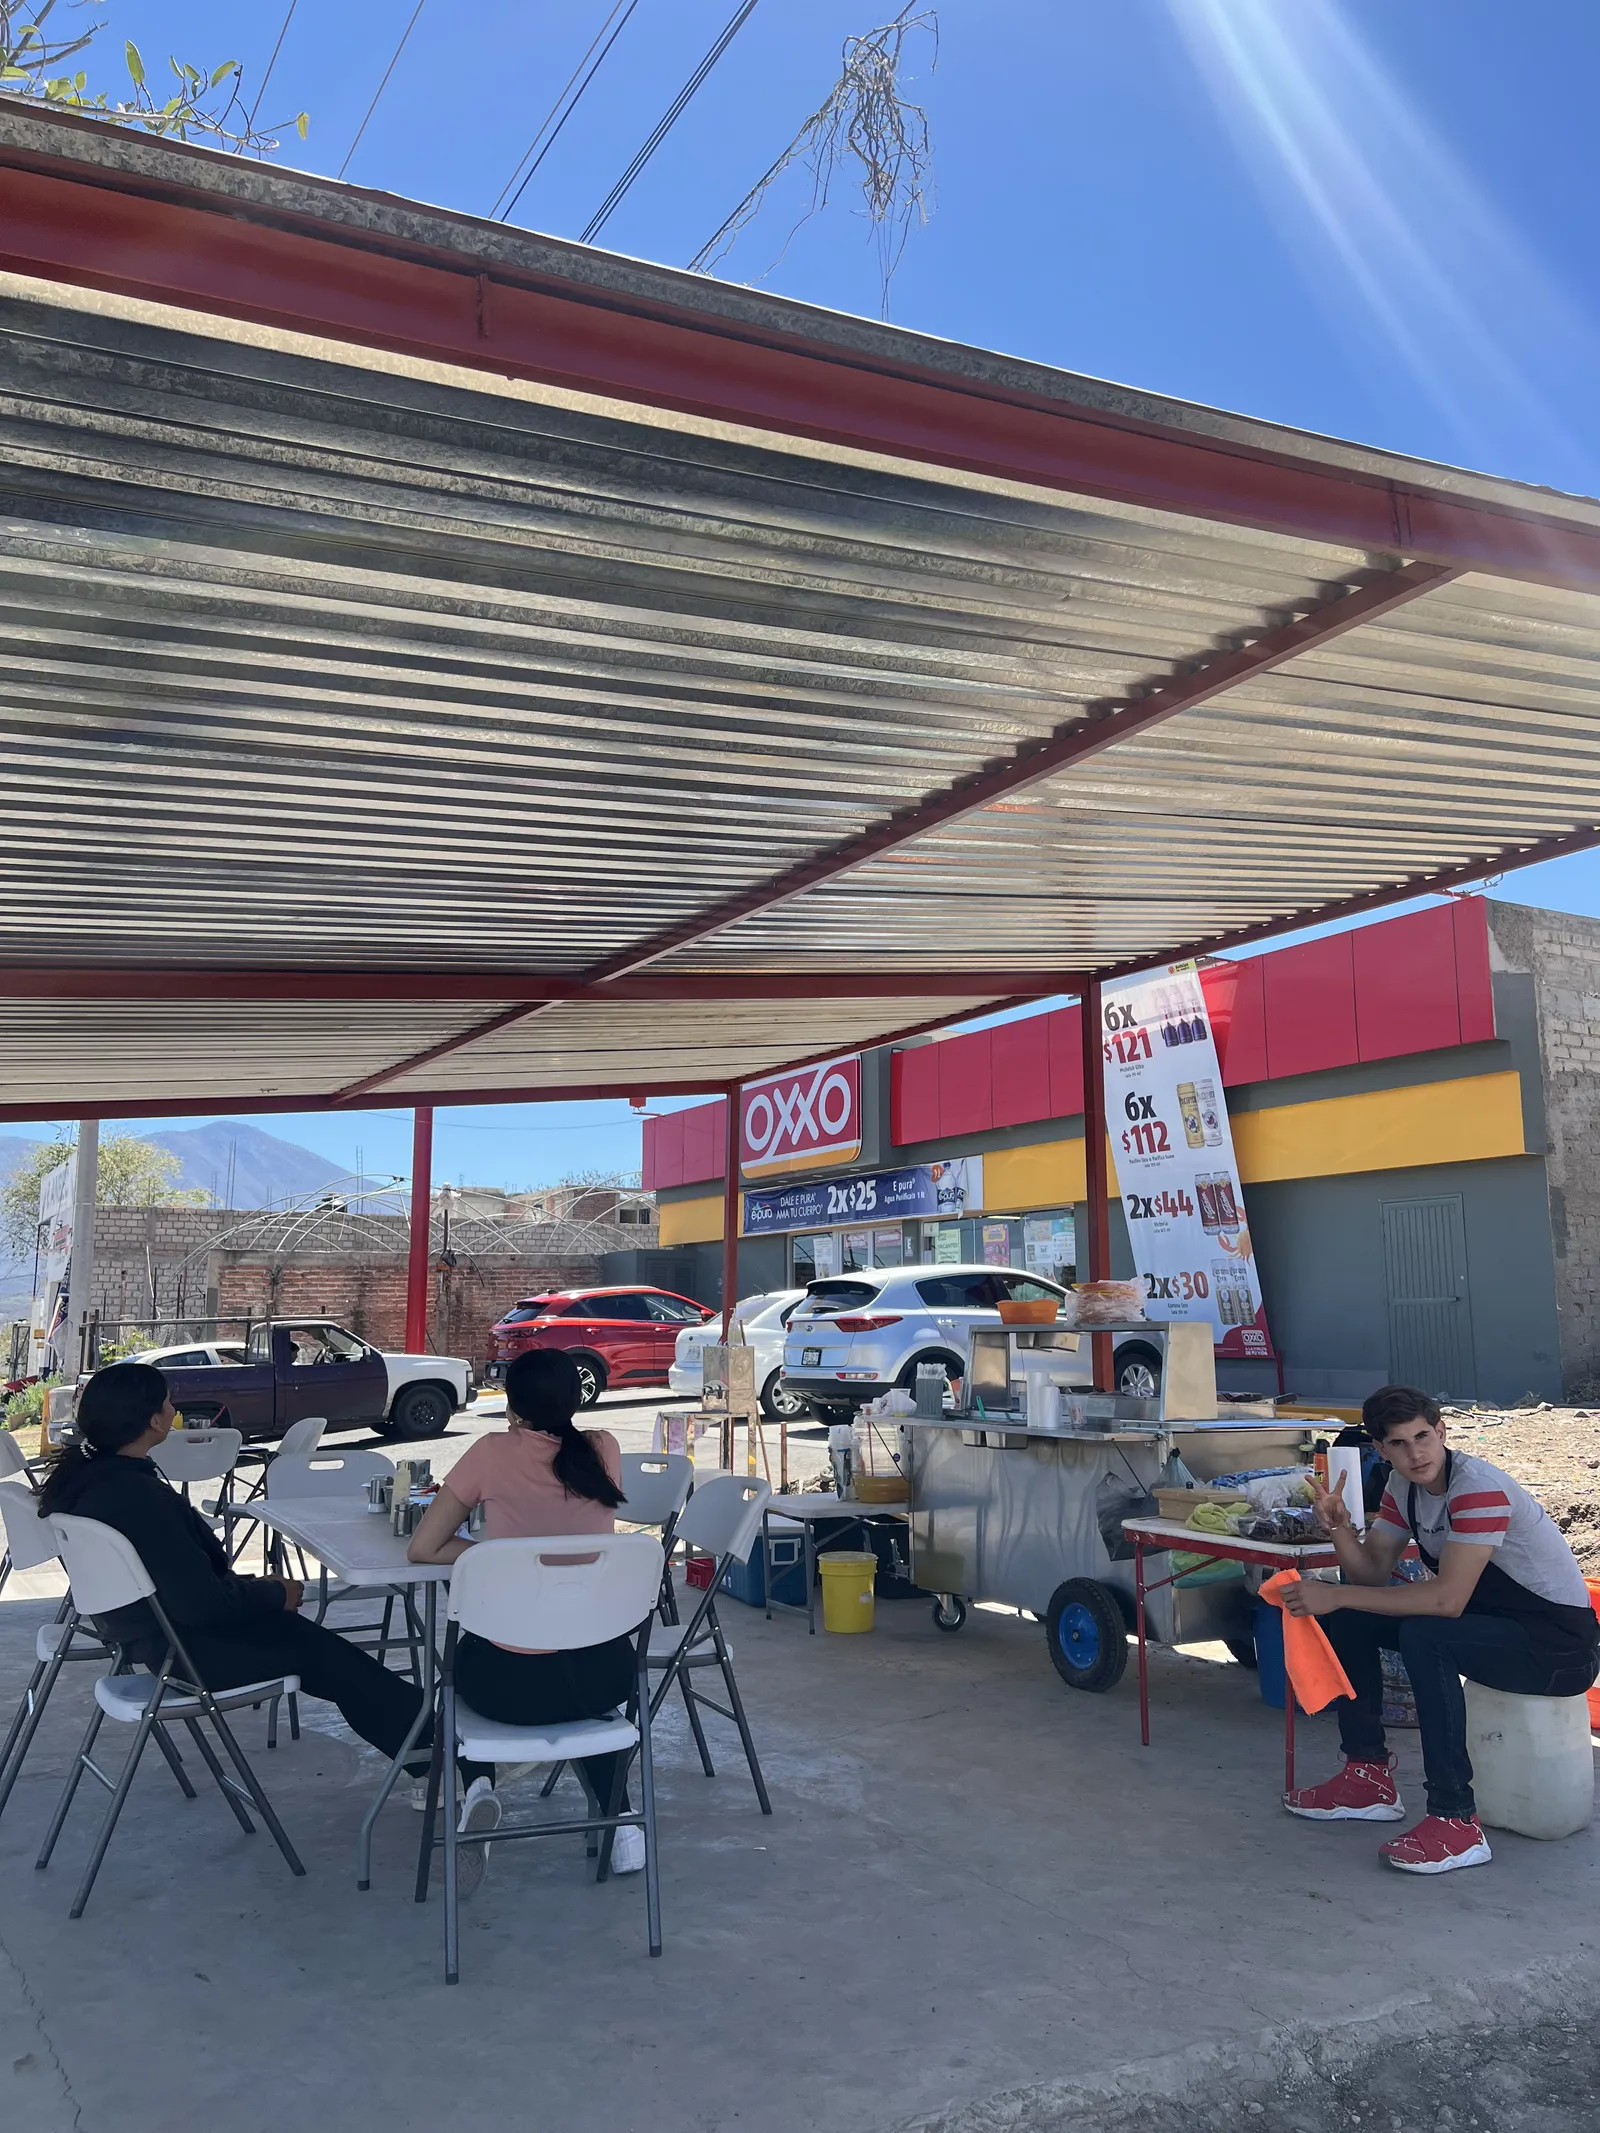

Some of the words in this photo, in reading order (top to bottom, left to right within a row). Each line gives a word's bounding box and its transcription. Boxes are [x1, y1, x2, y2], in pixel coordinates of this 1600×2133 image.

[1104, 1001, 1138, 1031] 6x
[1103, 1027, 1153, 1064] $121
[745, 1067, 852, 1161] OXXO
[1124, 1091, 1157, 1121] 6x
[1121, 1120, 1171, 1155] $112
[776, 1208, 790, 1219] AMA
[790, 1206, 798, 1218] TU
[798, 1204, 821, 1217] CUERPO
[780, 1196, 794, 1207] DALE
[795, 1194, 800, 1205] E
[800, 1192, 815, 1204] PURA
[827, 1179, 877, 1215] 2x$25
[1127, 1189, 1194, 1219] 2x$44
[1143, 1270, 1209, 1300] 2x$30
[1243, 1332, 1264, 1343] OXXO
